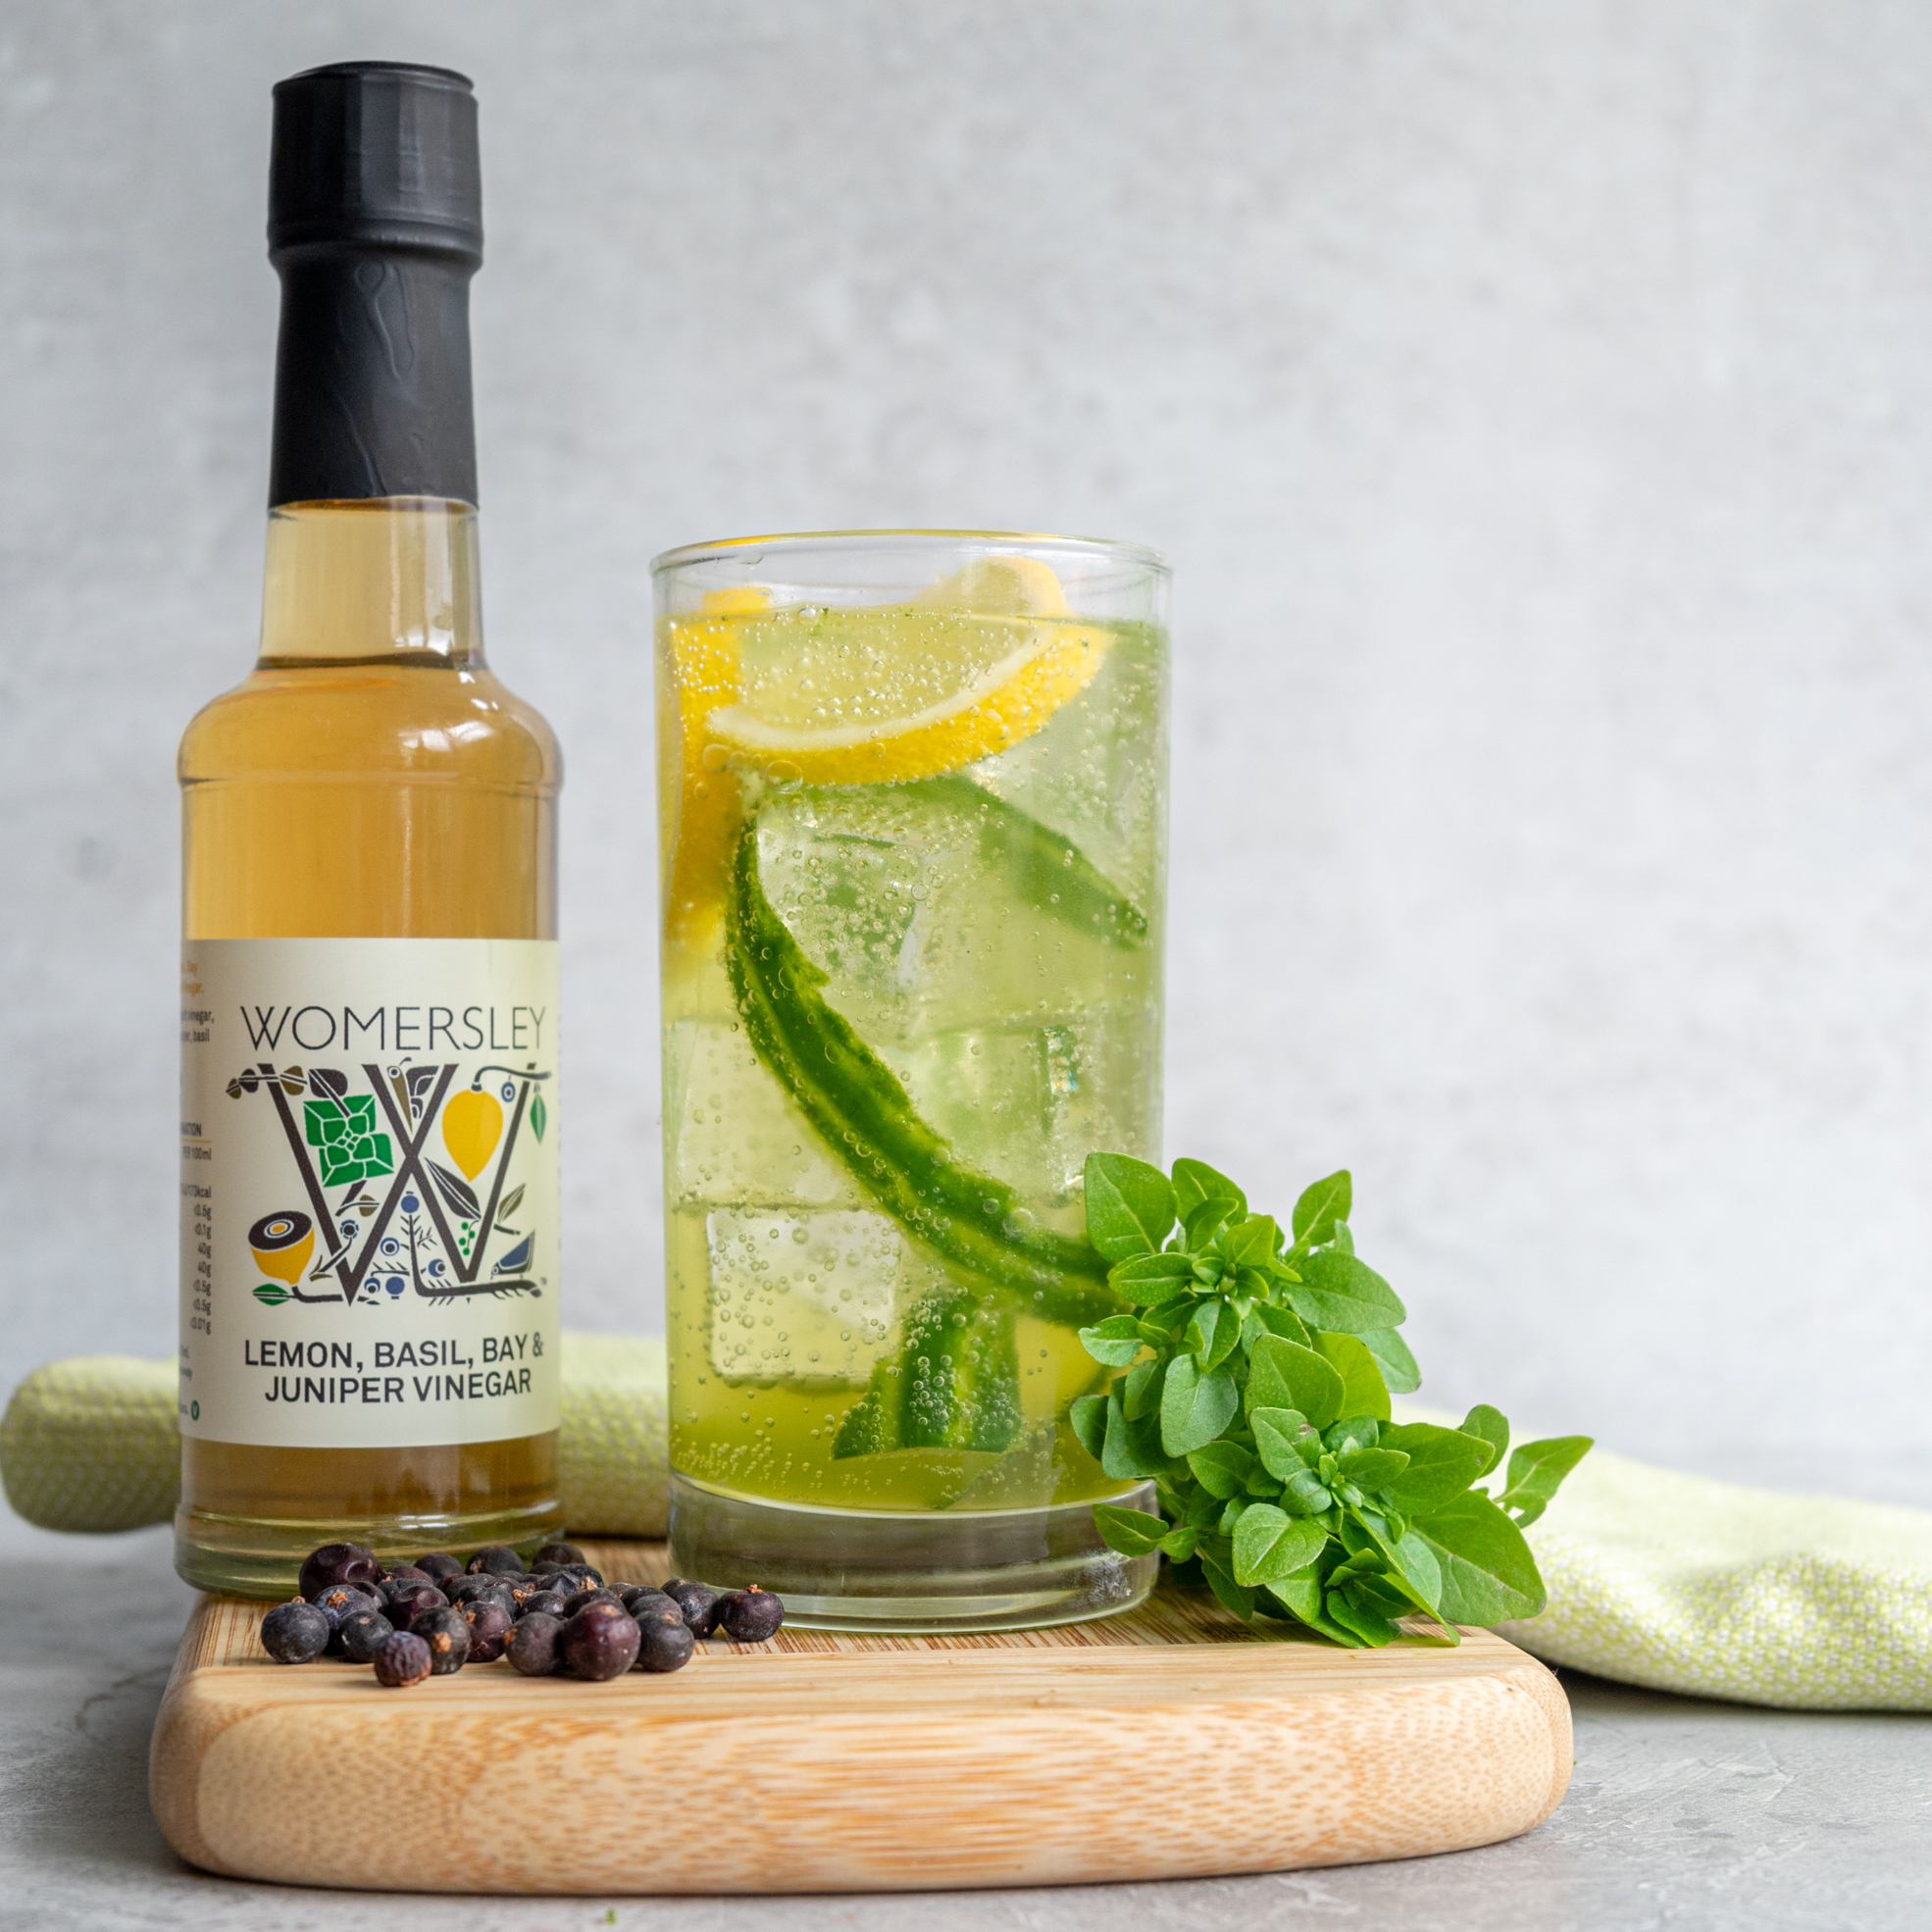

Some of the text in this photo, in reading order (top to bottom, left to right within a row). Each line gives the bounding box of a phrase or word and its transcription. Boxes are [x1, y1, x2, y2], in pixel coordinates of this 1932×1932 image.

[239, 1005, 546, 1051] WOMERSLEY
[245, 1331, 543, 1373] LEMON, BASIL, BAY &
[265, 1368, 532, 1403] JUNIPER VINEGAR
